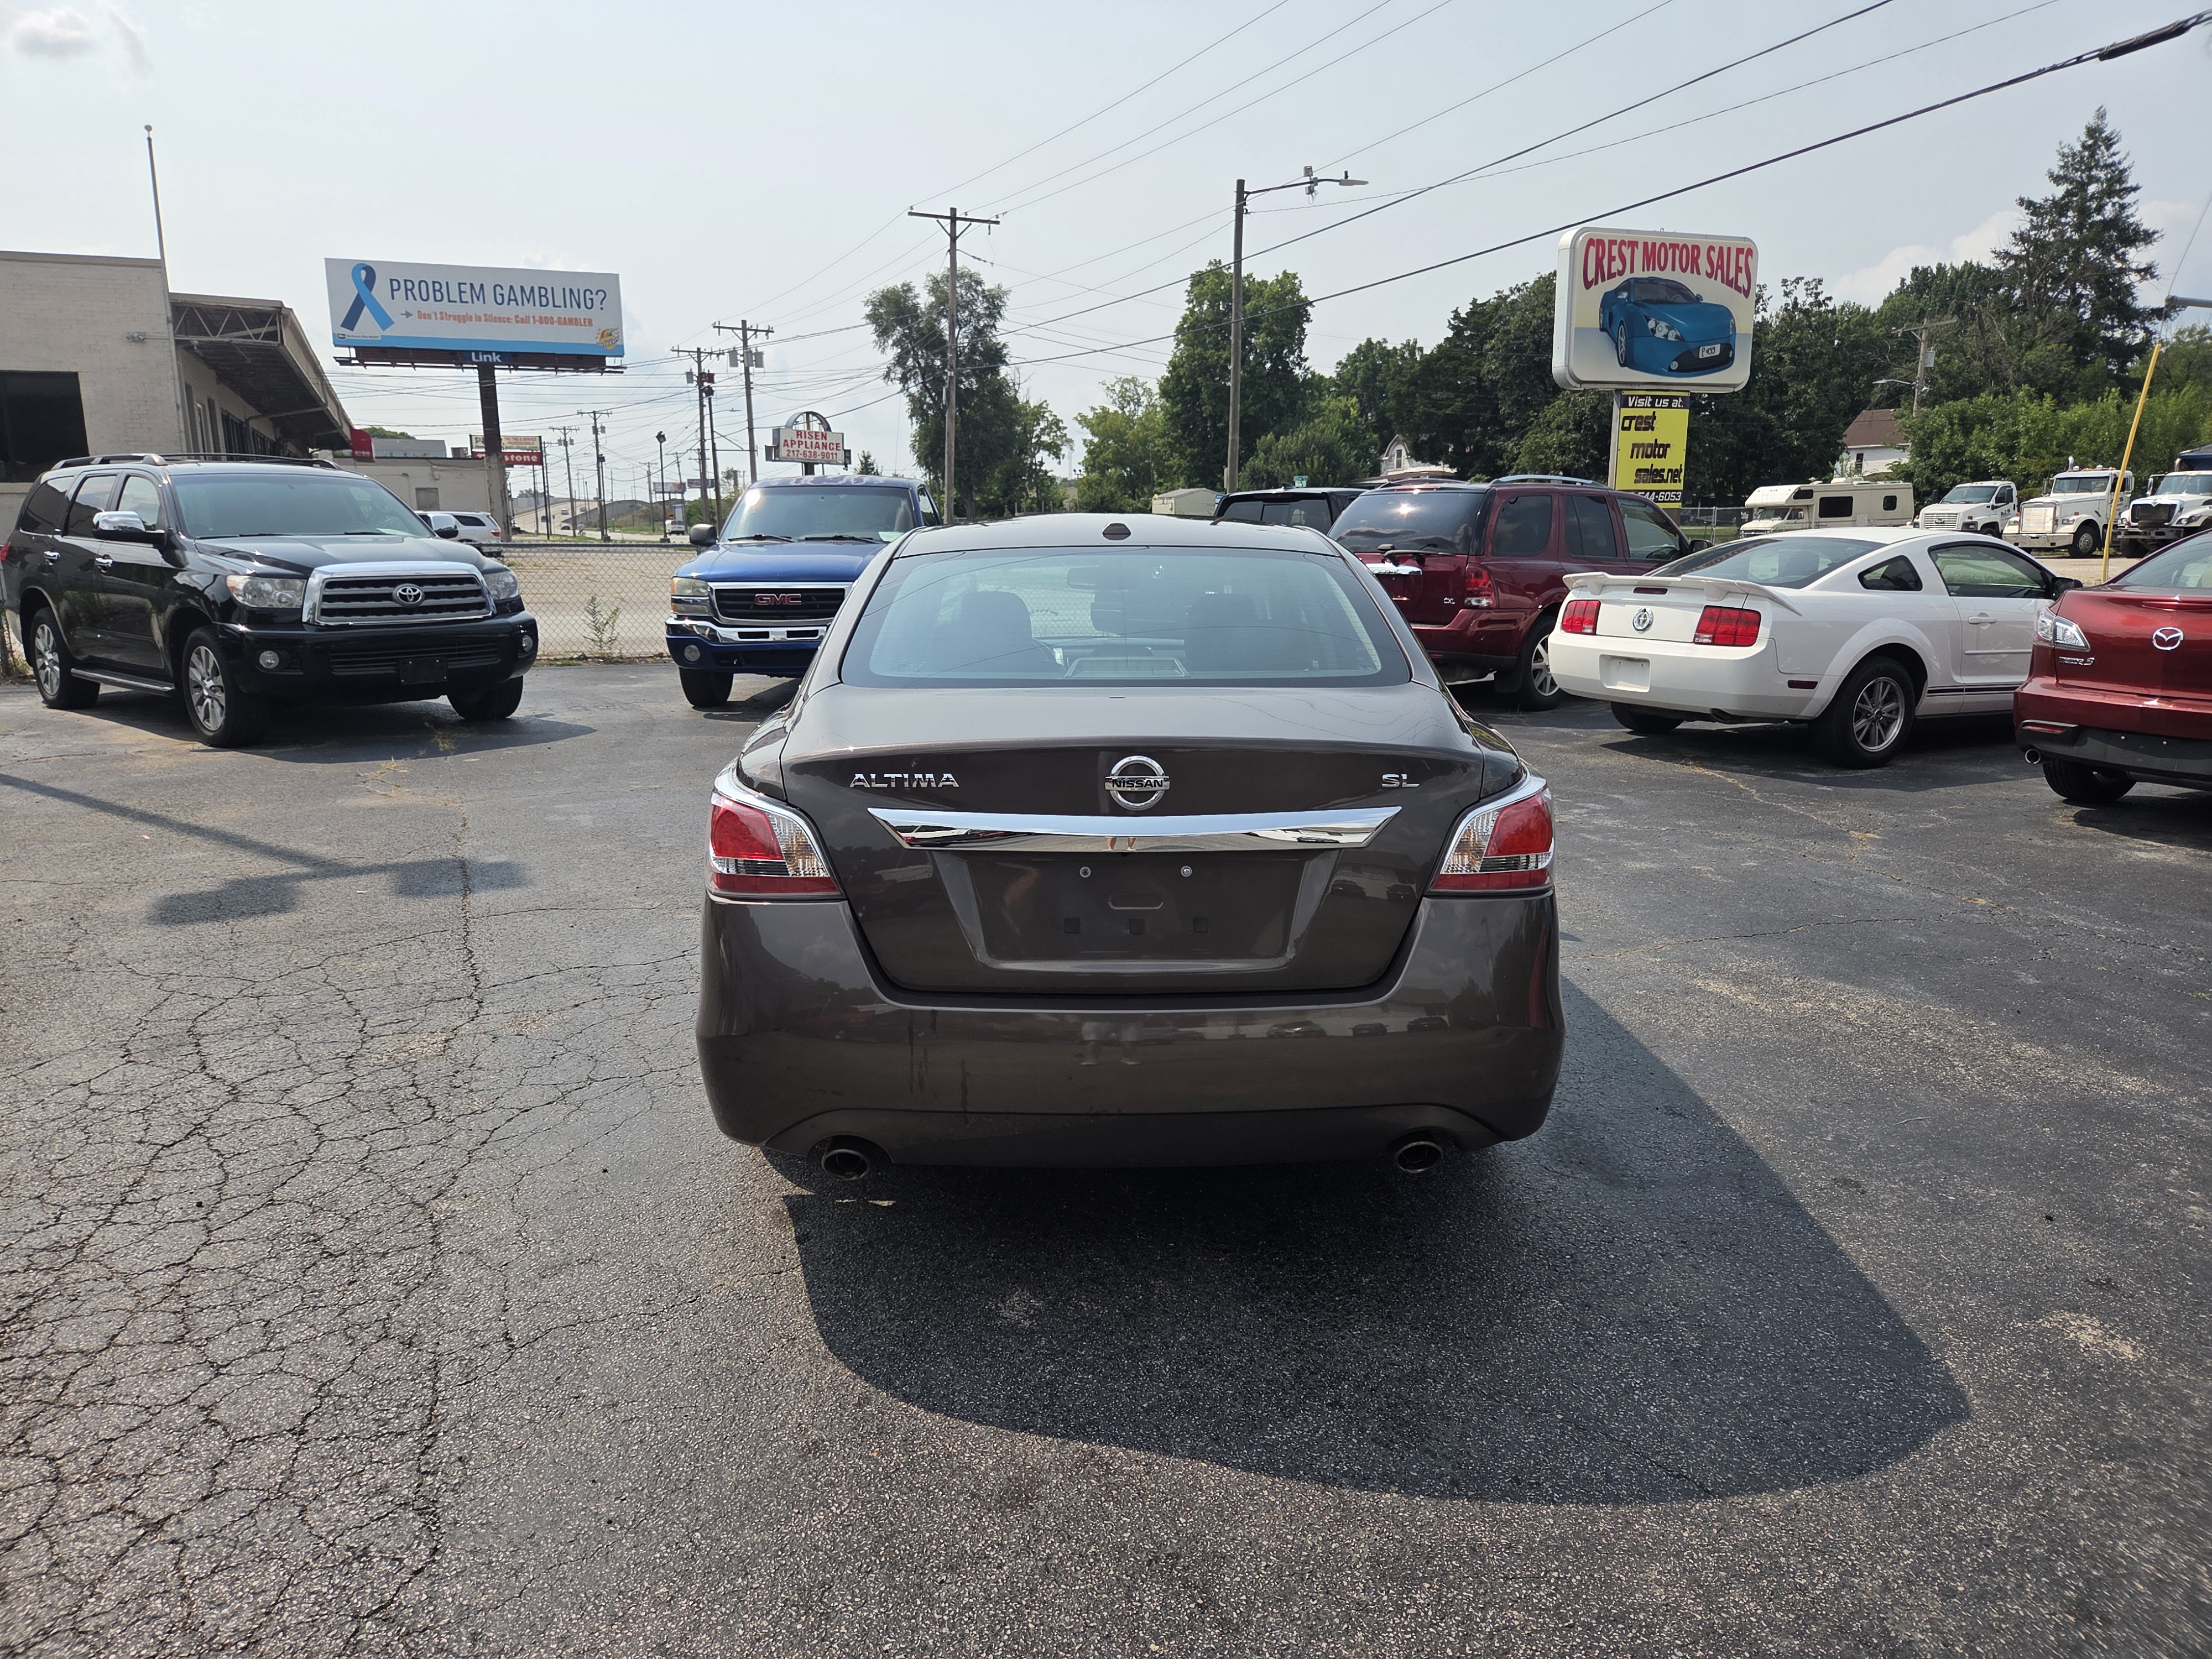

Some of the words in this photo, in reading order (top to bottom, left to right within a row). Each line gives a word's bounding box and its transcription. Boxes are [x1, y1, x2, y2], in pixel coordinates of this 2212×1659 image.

[1583, 238, 1639, 290] CREST
[1642, 242, 1701, 275] MOTOR
[1705, 245, 1753, 299] SALES
[389, 278, 486, 305] PROBLEM
[493, 284, 607, 311] GAMBLING?
[417, 310, 438, 320] Don't
[439, 311, 473, 324] Struggle
[474, 313, 482, 322] in
[514, 314, 530, 325] Call
[532, 315, 593, 327] 1-800-GAMBLER
[472, 352, 503, 362] Link
[1628, 396, 1652, 407] Visit
[1655, 398, 1669, 407] us
[1621, 410, 1656, 431] crest
[796, 430, 827, 441] RISEN
[783, 440, 841, 451] APPLIANCE
[1630, 439, 1671, 459] motor
[786, 450, 838, 460] 217-638-9011
[1634, 463, 1683, 484] sales.net
[755, 593, 802, 606] GMC
[849, 773, 959, 788] ALTIMA
[1112, 779, 1163, 788] NISSAN
[1381, 774, 1420, 787] SL
